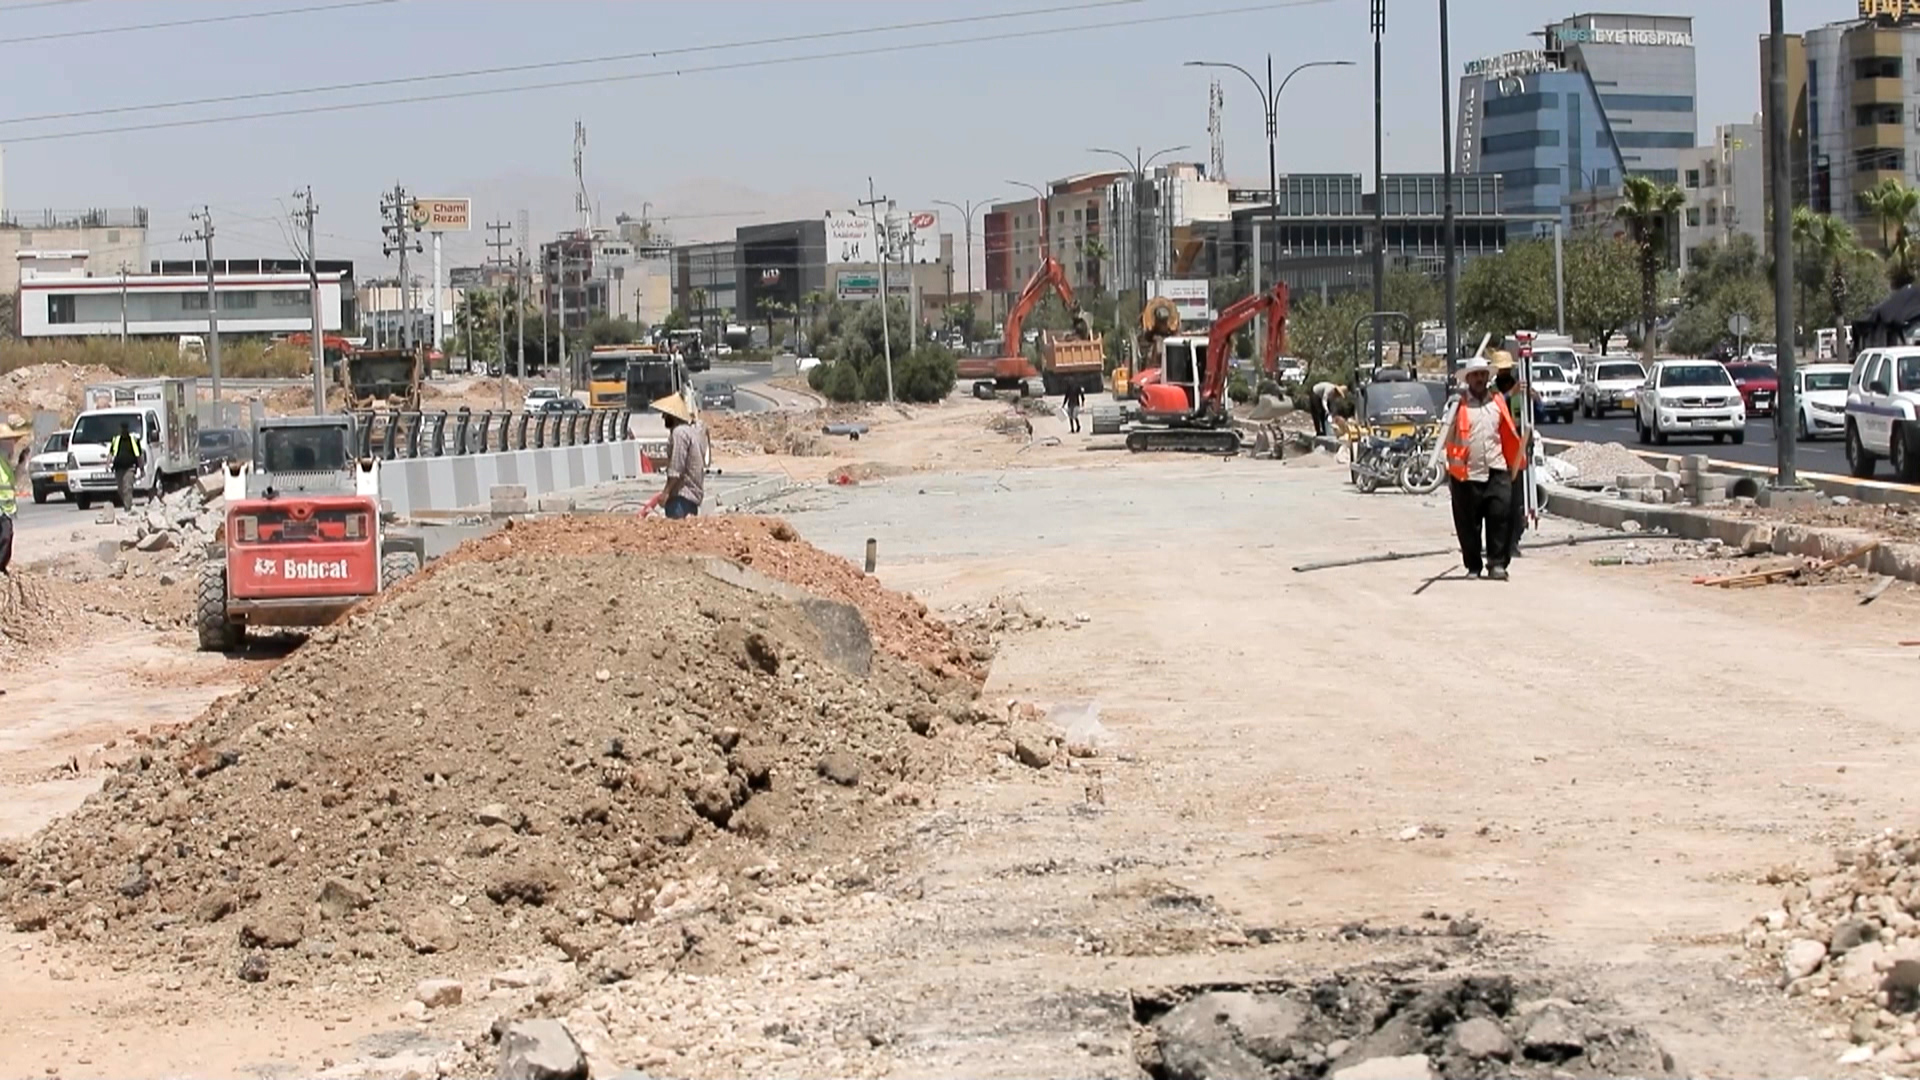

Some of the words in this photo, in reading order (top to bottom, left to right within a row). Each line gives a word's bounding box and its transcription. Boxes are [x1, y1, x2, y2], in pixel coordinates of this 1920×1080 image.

[1596, 29, 1625, 44] EYE
[1628, 30, 1692, 46] HOSPITAL
[433, 203, 466, 213] Chami
[433, 213, 466, 223] Rezan
[283, 559, 349, 579] Bobcat
